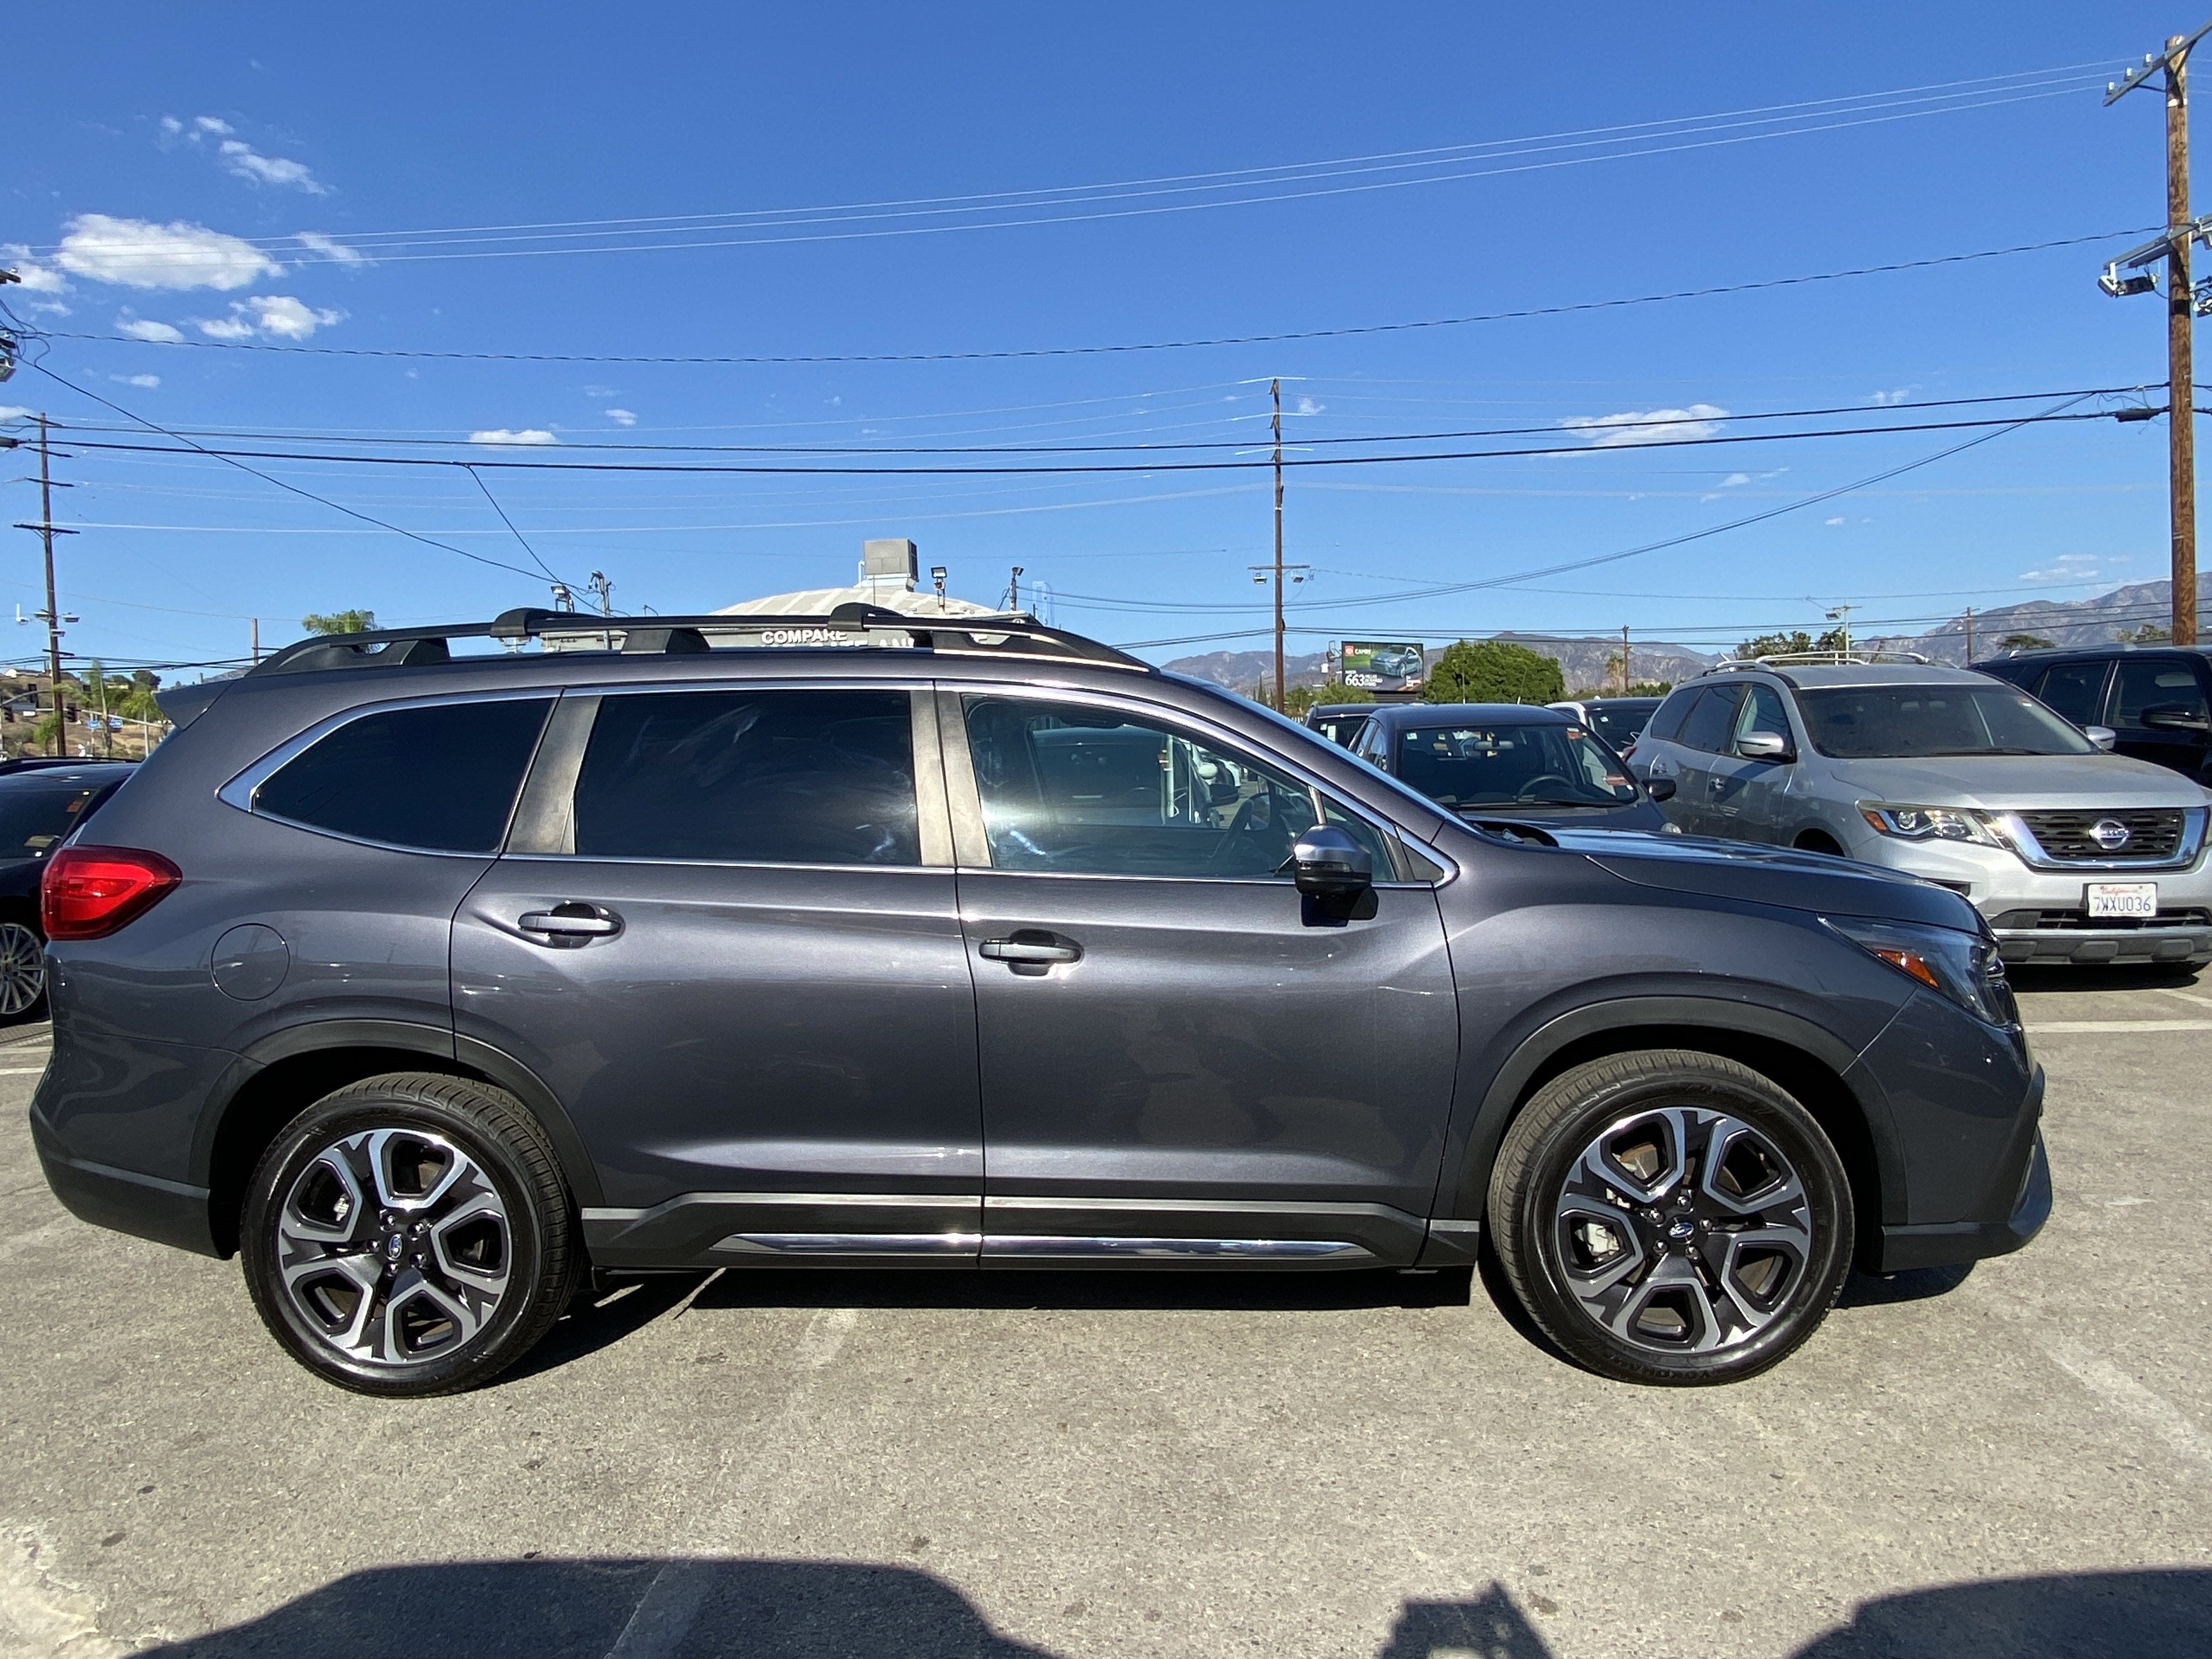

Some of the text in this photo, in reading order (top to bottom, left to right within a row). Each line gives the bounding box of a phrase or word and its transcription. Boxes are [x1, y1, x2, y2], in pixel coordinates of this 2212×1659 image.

[761, 629, 847, 644] COMPARE
[1345, 674, 1364, 686] 663
[2094, 896, 2151, 911] 7WXU036
